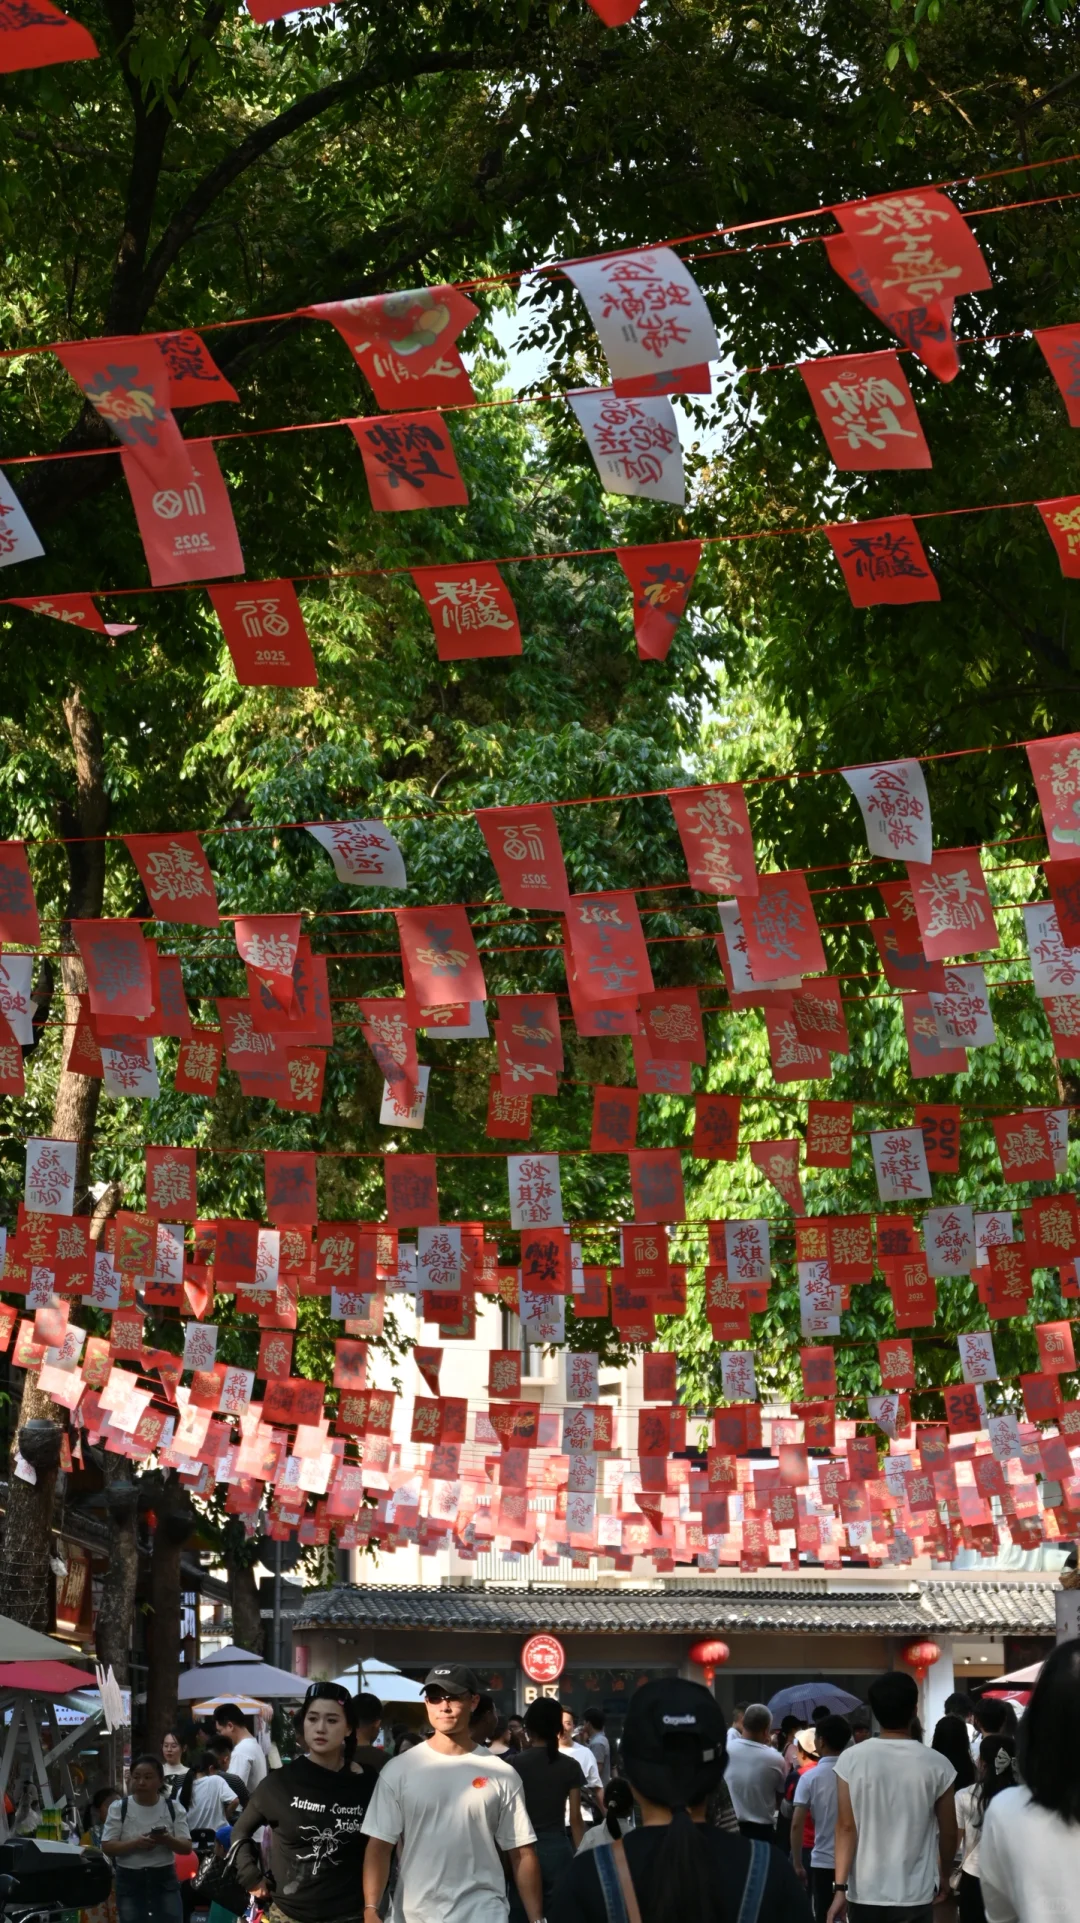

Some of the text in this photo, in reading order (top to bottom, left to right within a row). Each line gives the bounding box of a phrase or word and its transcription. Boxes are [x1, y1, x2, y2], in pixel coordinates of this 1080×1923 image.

[843, 532, 912, 559] 平安
[430, 579, 500, 605] 平安
[232, 598, 290, 638] 福
[256, 650, 286, 661] 2025
[288, 1060, 320, 1080] 成功
[134, 1214, 155, 1228] 2025
[942, 1213, 961, 1231] 金
[432, 1235, 452, 1251] 福
[735, 1227, 760, 1244] 蛇
[321, 1237, 356, 1255] 成功
[633, 1237, 658, 1261] 福
[322, 1252, 358, 1275] 上岸
[942, 1248, 961, 1265] 瑞
[428, 1267, 452, 1285] 财
[637, 1268, 654, 1276] 2025
[737, 1262, 758, 1278] 谁
[904, 1264, 928, 1287] 福
[229, 1373, 247, 1387] 蛇
[574, 1411, 587, 1425] 金
[290, 1796, 326, 1812] Autumn
